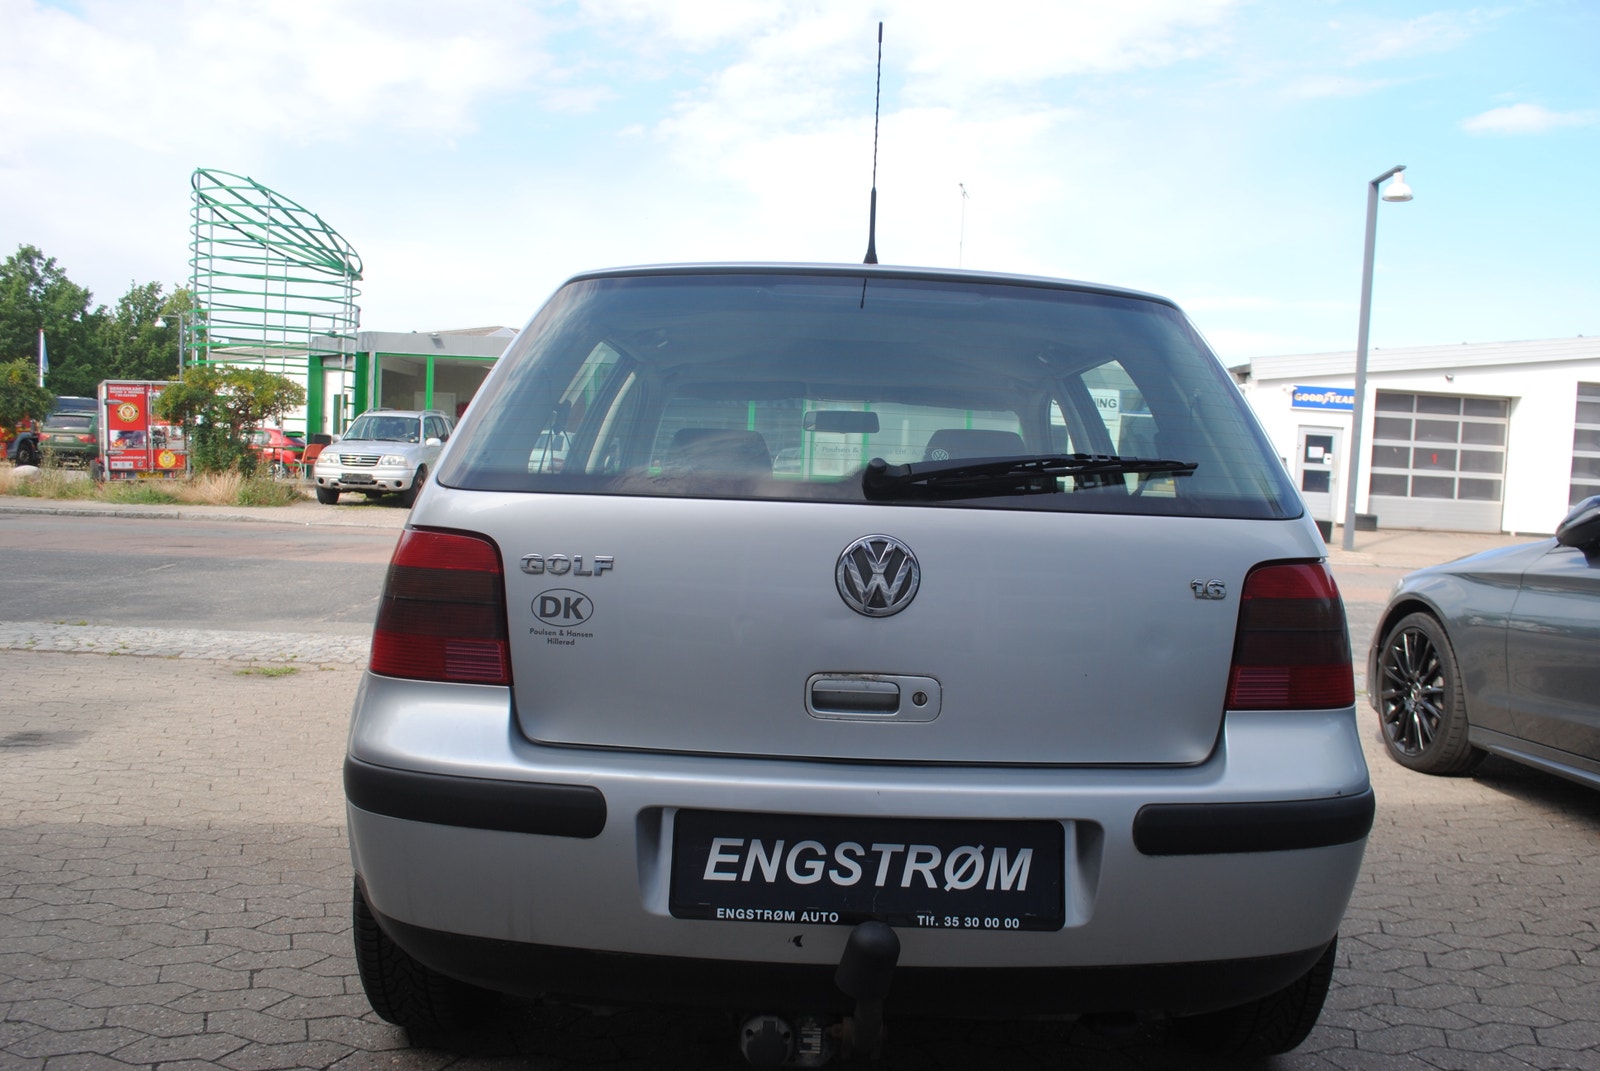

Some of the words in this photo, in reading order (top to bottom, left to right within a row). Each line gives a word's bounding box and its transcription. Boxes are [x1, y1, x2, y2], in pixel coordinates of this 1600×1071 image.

[1094, 397, 1118, 409] ING
[1294, 391, 1355, 405] GOODYEAR
[519, 553, 615, 577] GOLF
[539, 596, 584, 619] DK
[529, 627, 557, 636] Poulsen
[566, 630, 593, 638] Hansen
[547, 637, 575, 645] Hillerød
[702, 836, 1034, 893] ENGSTRØM
[716, 907, 796, 922] ENGSTRØM
[800, 911, 840, 924] AUTO
[916, 915, 940, 927] Tlf.
[943, 916, 960, 928] 35
[964, 917, 980, 929] 30
[984, 918, 1001, 929] 00
[1004, 918, 1021, 930] 00
